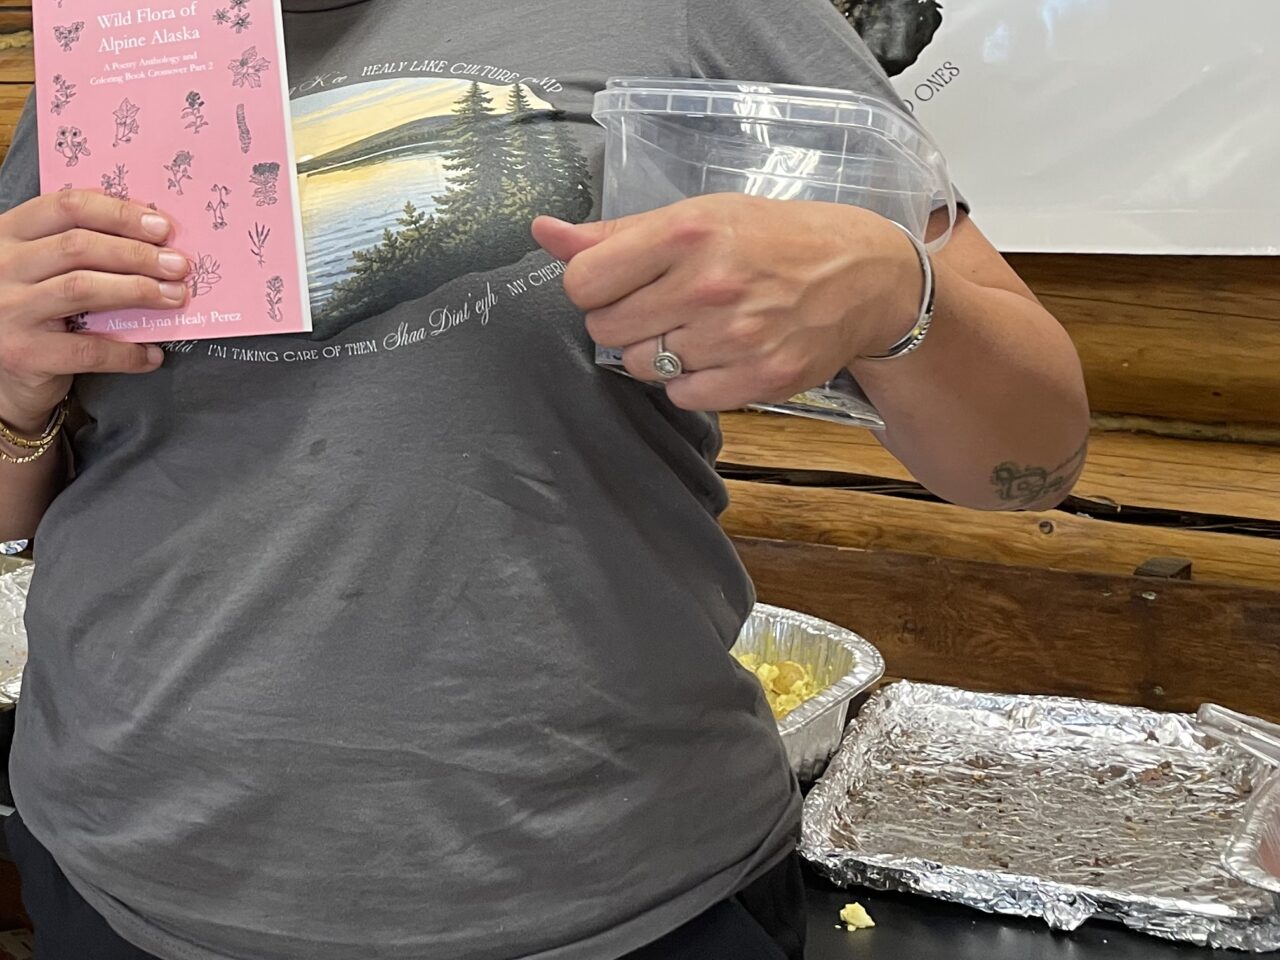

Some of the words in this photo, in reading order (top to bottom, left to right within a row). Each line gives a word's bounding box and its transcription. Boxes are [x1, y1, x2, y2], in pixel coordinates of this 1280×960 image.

[97, 11, 132, 29] Wild
[136, 8, 176, 23] Flora
[180, 1, 198, 17] of
[98, 35, 146, 55] Alpine
[151, 26, 200, 45] Alaska
[89, 75, 124, 86] Coloring
[125, 72, 146, 82] Book
[189, 62, 207, 73] Part
[207, 61, 215, 71] 2
[103, 63, 111, 72] A
[111, 61, 137, 71] Poetry
[139, 55, 181, 67] Anthology
[183, 51, 198, 61] and
[361, 61, 408, 77] HEALY
[410, 60, 448, 73] LAKE
[450, 62, 520, 83] CULTURE
[914, 61, 960, 102] ONES
[106, 319, 139, 331] Alissa
[141, 317, 172, 331] Lynn
[175, 313, 208, 327] Healy
[210, 311, 242, 323] Perez
[207, 344, 227, 359] I'M
[232, 348, 279, 362] TAKING
[283, 349, 319, 361] CARE
[322, 345, 341, 358] OF
[344, 340, 378, 357] THEM
[506, 278, 528, 296] MY
[528, 259, 568, 286] CHERI
